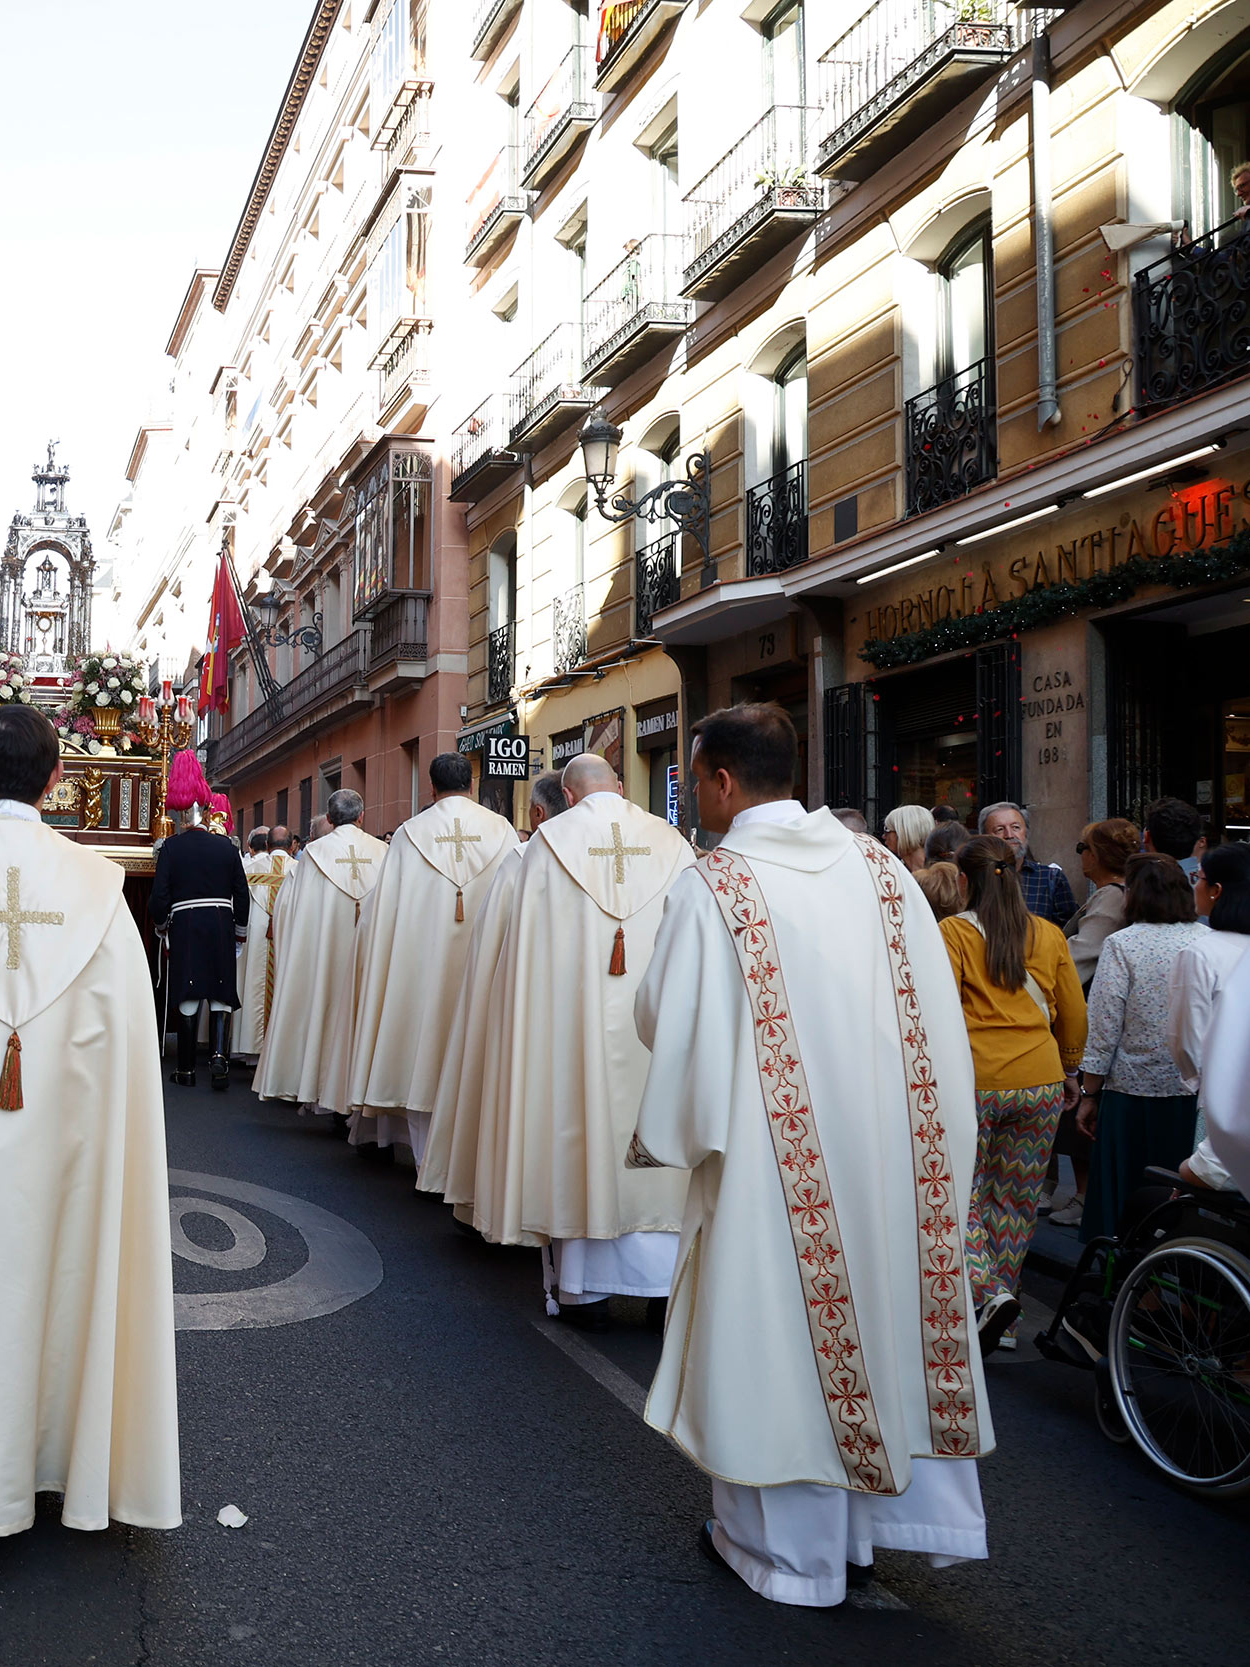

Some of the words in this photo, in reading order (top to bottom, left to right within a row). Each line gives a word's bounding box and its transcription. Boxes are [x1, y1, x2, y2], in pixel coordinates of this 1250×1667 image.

[865, 584, 955, 640] HORNO
[959, 568, 1000, 616] LA
[1033, 671, 1072, 692] CASA
[1022, 692, 1085, 720] FUNDADA
[637, 714, 665, 738] RAMEN
[1046, 721, 1062, 739] EN
[489, 737, 527, 758] IGO
[489, 761, 526, 776] RAMEN
